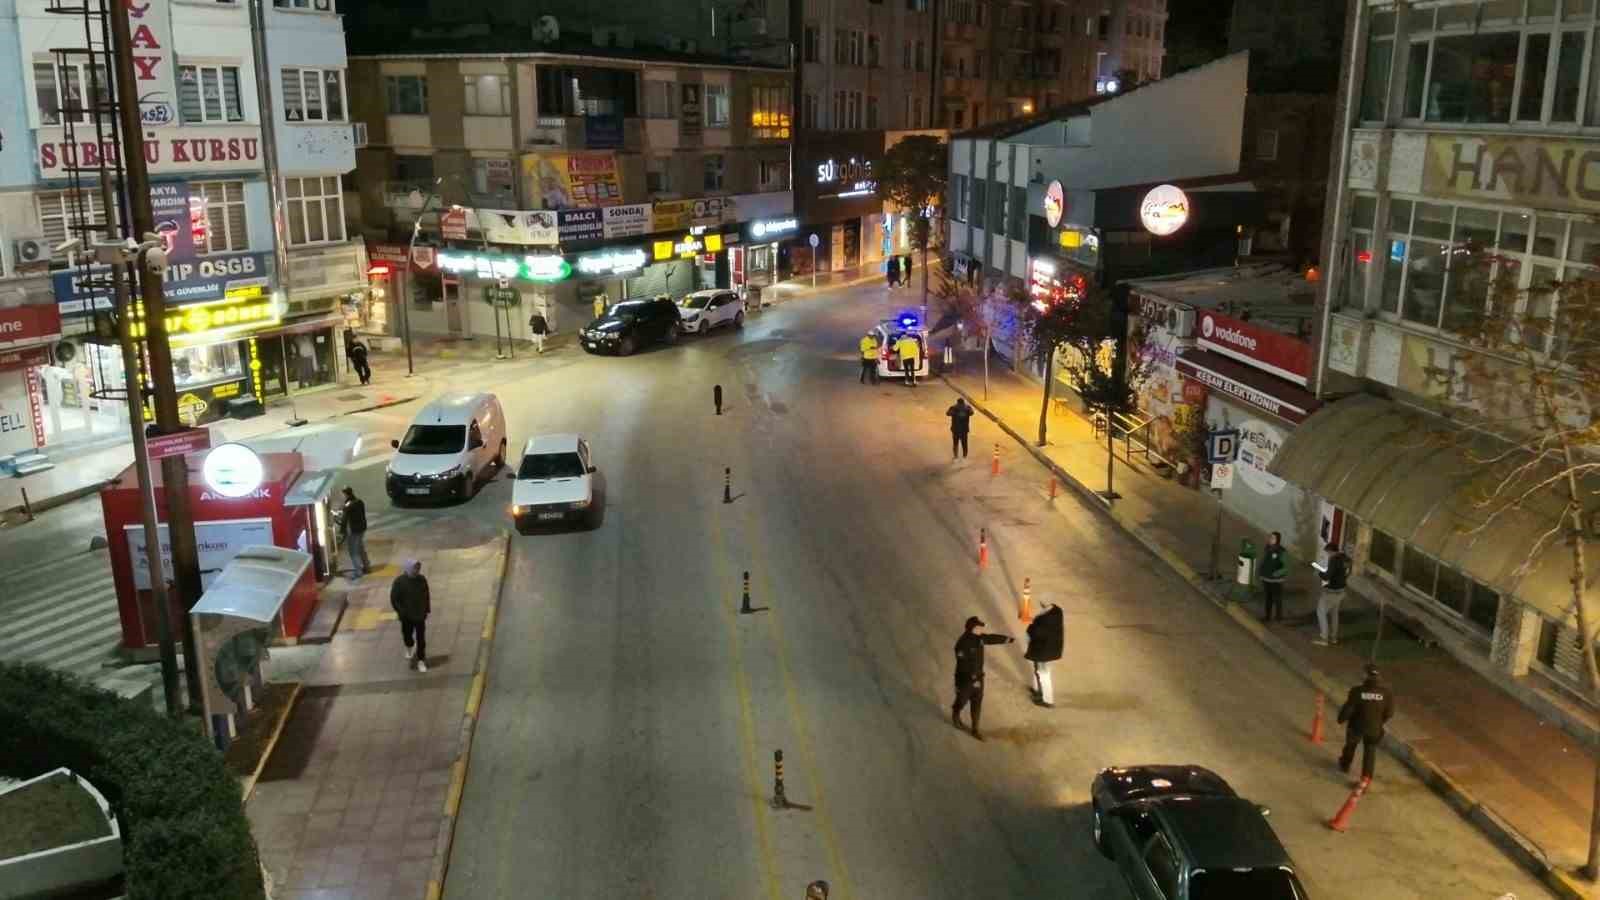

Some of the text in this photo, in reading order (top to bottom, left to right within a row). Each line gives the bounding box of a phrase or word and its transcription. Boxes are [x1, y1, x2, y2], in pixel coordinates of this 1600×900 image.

[41, 131, 258, 168] SÜRÜÜ KURSU
[198, 258, 256, 283] OSGB
[0, 319, 23, 333] ne
[1215, 326, 1257, 351] vodafone
[1219, 438, 1232, 456] D
